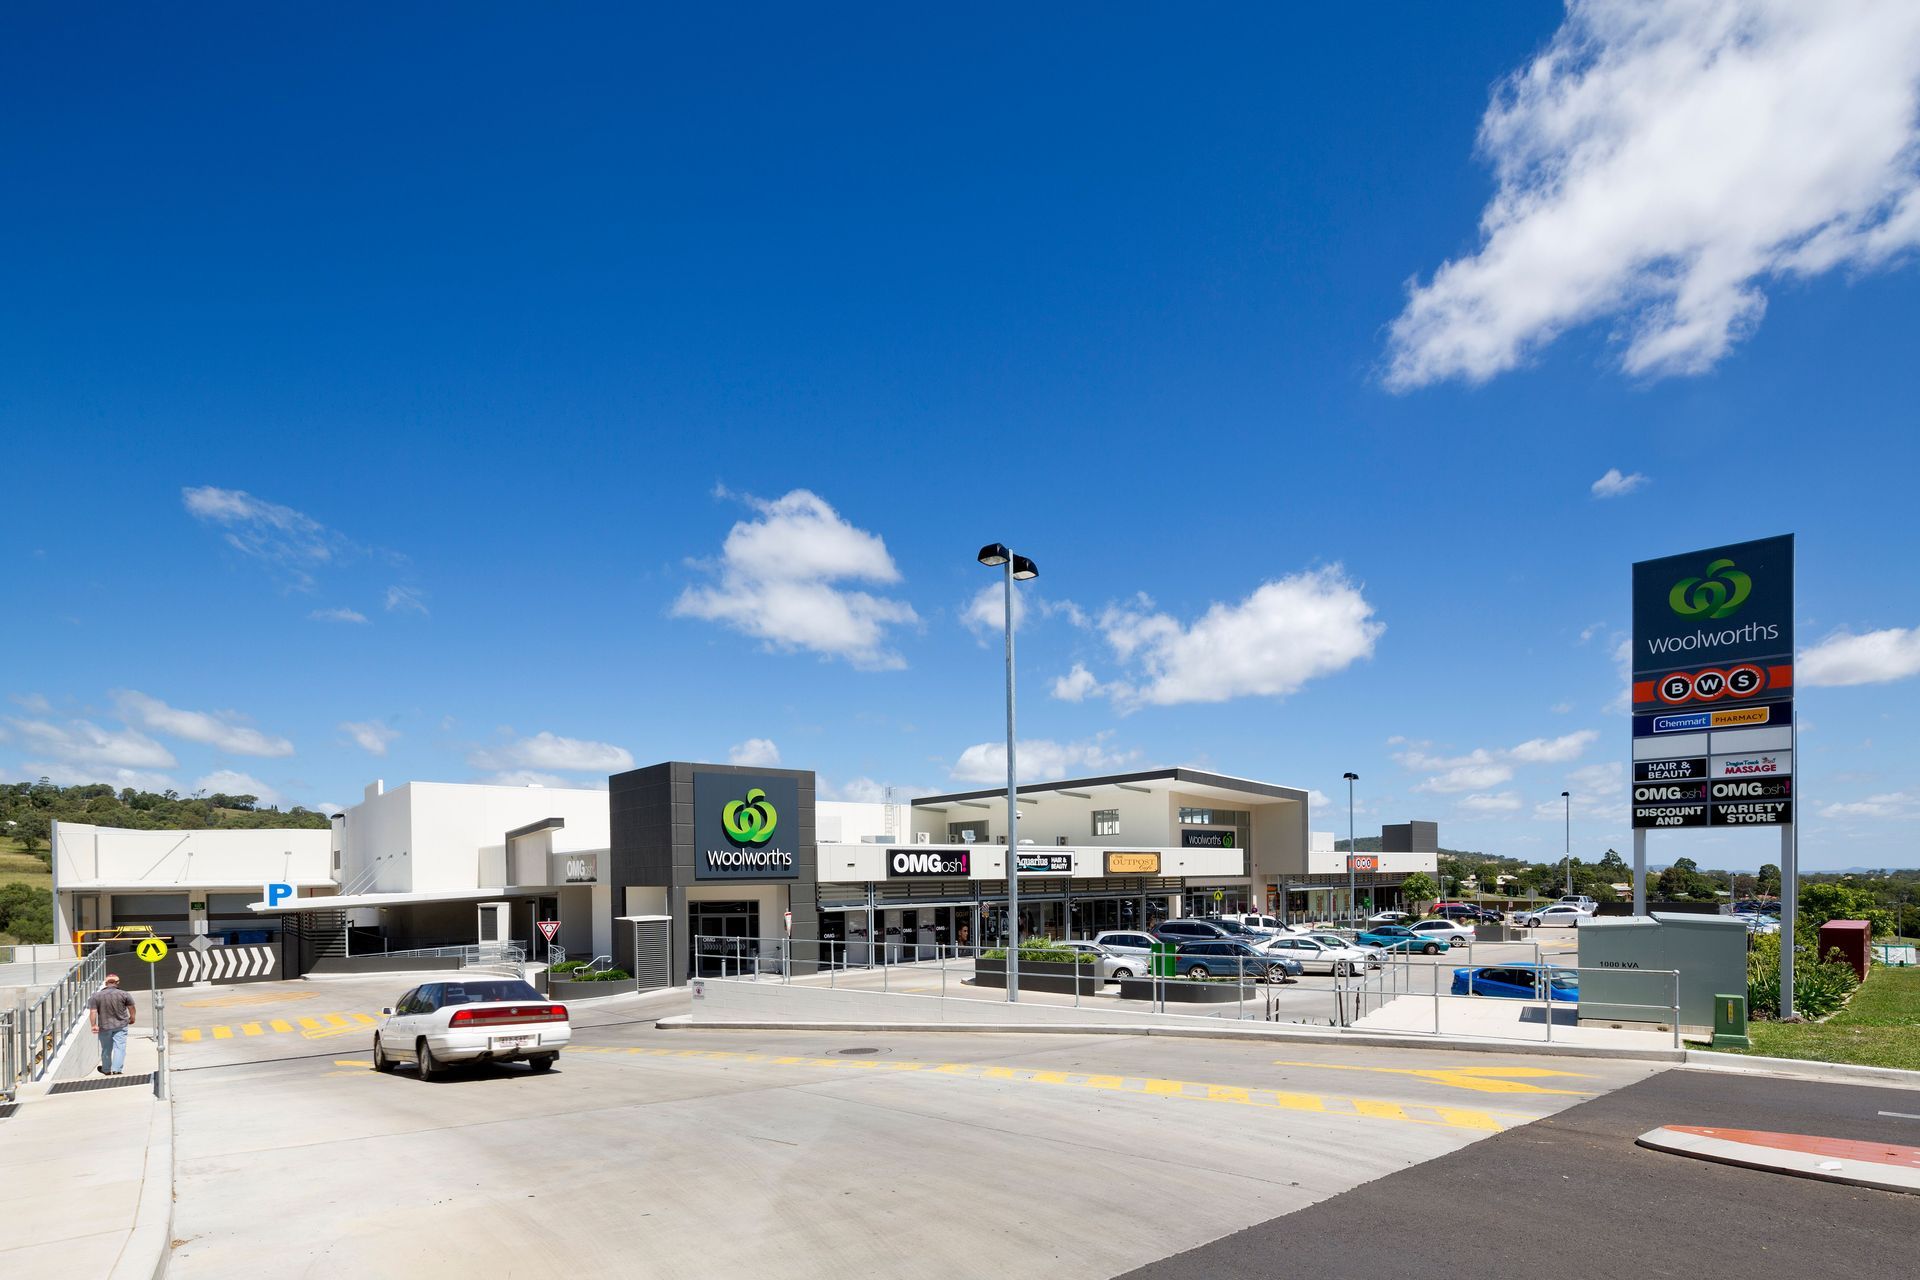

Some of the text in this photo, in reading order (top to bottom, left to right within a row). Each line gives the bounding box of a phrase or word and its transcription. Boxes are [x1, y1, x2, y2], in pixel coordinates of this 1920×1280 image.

[1648, 622, 1778, 654] Woolworths
[1659, 713, 1763, 728] Chemmart PHARMACY
[1649, 761, 1690, 771] HAIR &
[1725, 764, 1777, 774] MASSAGE
[1648, 769, 1692, 779] BEAUTY
[1635, 785, 1707, 801] OMGosh!
[1712, 779, 1790, 797] OMGosh!
[1636, 806, 1704, 817] DISCOUNT
[1718, 803, 1785, 814] VARIETY
[1655, 816, 1684, 826] AND
[1727, 812, 1776, 823] STORE
[1188, 834, 1221, 845] Woolworths
[707, 847, 792, 866] Woolworths
[1113, 858, 1154, 866] OUTPOST
[893, 853, 967, 873] OMGosh!
[269, 884, 292, 906] P
[1621, 961, 1639, 969] kVA
